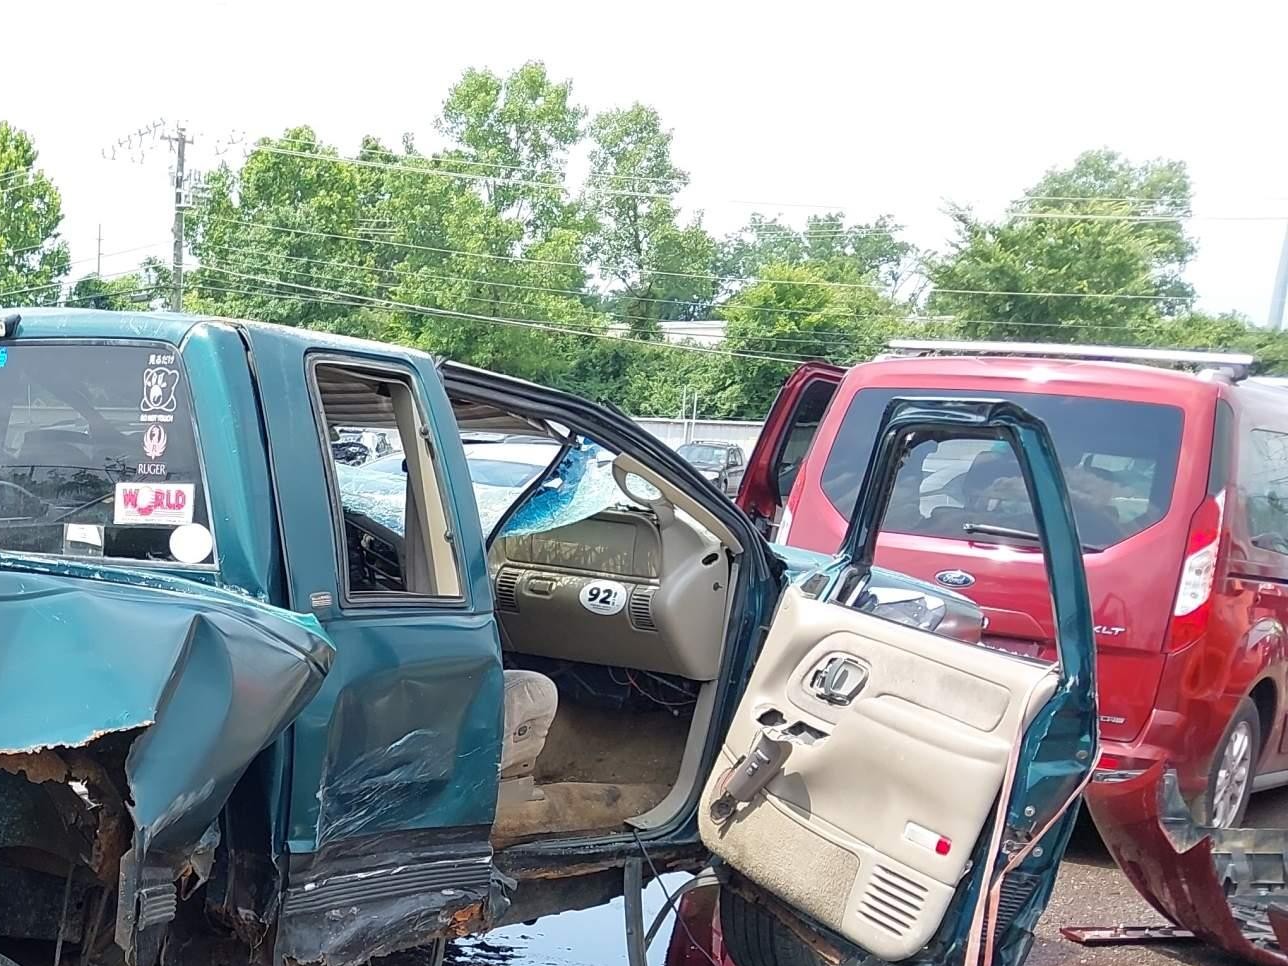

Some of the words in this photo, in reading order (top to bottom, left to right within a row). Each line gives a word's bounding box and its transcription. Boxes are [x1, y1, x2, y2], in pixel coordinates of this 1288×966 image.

[137, 463, 166, 475] RUGER
[942, 573, 966, 585] Ford
[587, 586, 613, 606] 92
